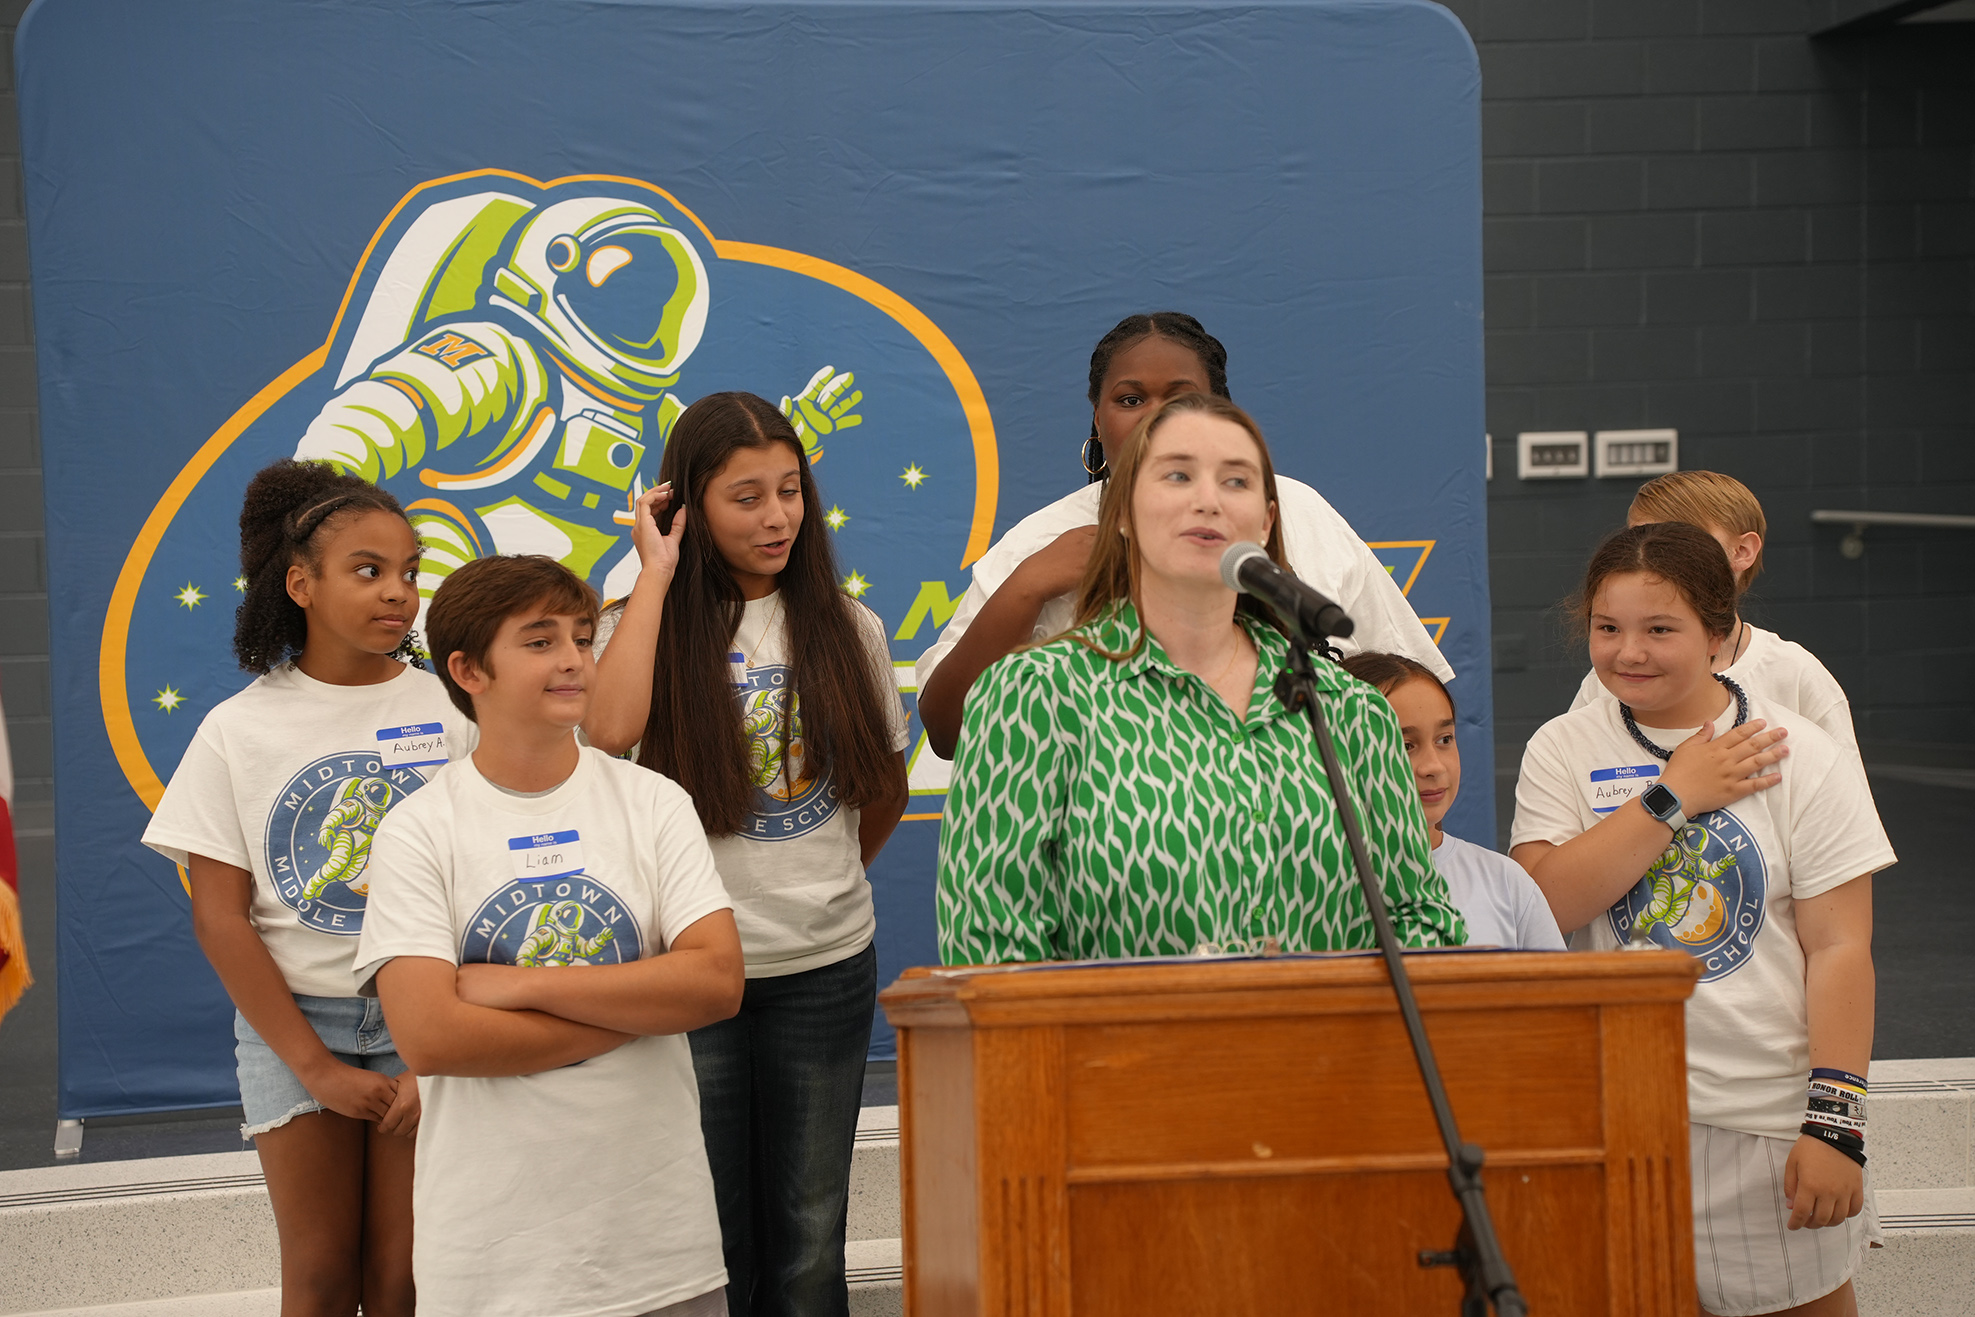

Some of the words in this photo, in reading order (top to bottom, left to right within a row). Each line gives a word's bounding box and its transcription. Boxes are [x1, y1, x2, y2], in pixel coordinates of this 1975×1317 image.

[418, 333, 488, 368] M
[400, 726, 421, 734] Hello
[393, 740, 434, 754] Aubrey
[436, 737, 445, 748] A.
[1615, 767, 1637, 775] Hello
[284, 760, 411, 811] MIDTOW
[1596, 784, 1633, 799] Aubrey
[784, 785, 839, 831] SCHO
[532, 834, 554, 844] Hello
[526, 853, 564, 868] Liam
[475, 883, 623, 939] MIDTOWN
[1706, 898, 1759, 972] CHOOL
[1812, 1083, 1837, 1095] HONOR
[1839, 1090, 1859, 1102] ROLL
[1823, 1130, 1839, 1140] 9/11
